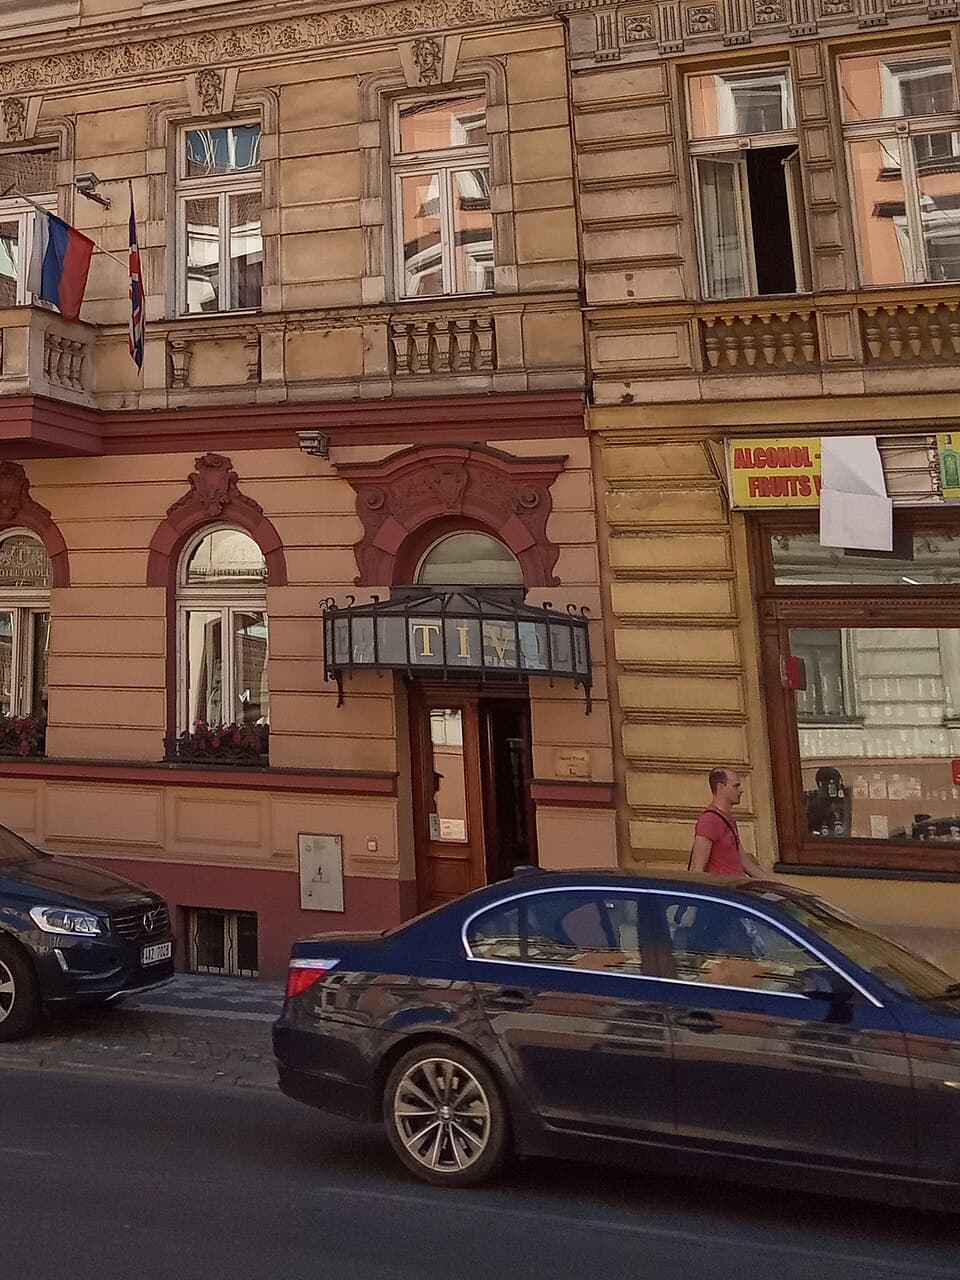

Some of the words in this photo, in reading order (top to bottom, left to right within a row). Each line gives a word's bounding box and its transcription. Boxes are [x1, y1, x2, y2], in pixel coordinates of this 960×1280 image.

[733, 446, 813, 469] ALCOHOL
[748, 474, 812, 498] FRUITS
[411, 623, 583, 665] TIVOLI
